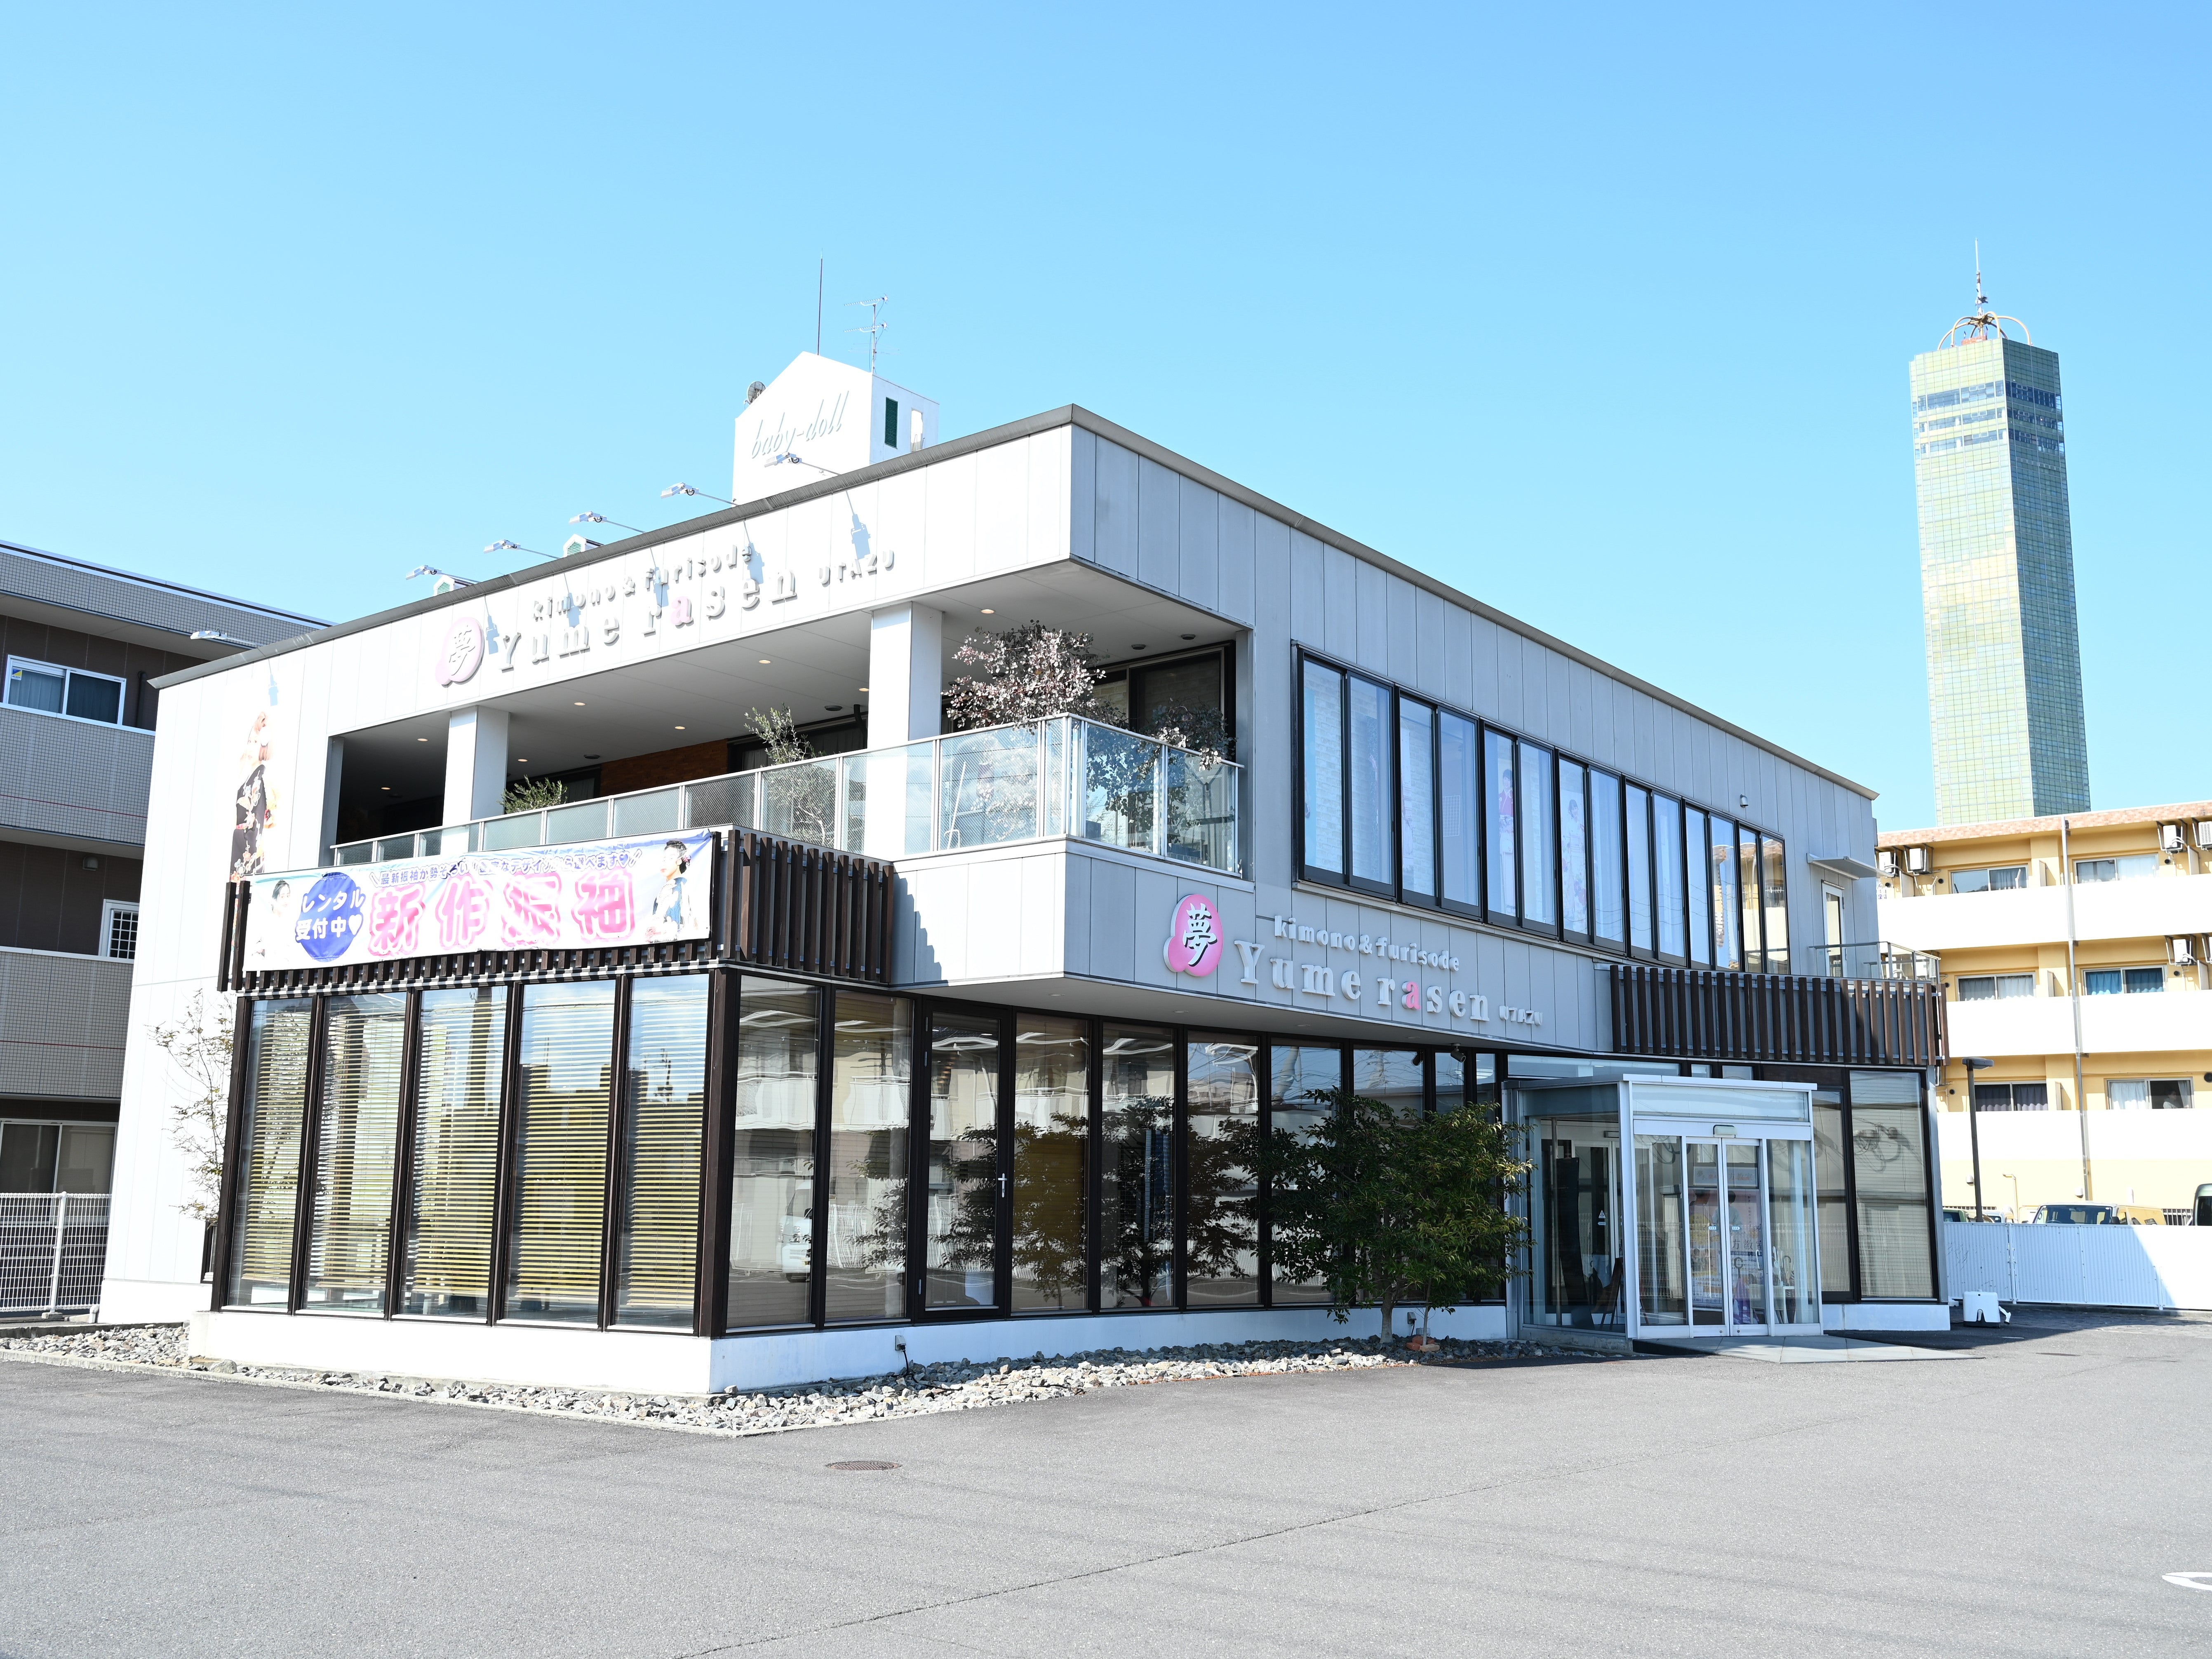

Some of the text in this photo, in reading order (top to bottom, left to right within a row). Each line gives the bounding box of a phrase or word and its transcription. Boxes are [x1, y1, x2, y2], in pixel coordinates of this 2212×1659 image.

[752, 390, 849, 459] baby-doll
[498, 568, 797, 672] Yume rasen
[302, 888, 365, 913] レンタル
[1182, 902, 1218, 967] 夢
[1234, 940, 1490, 1022] Yume rasen
[1499, 1005, 1543, 1026] UTAZU
